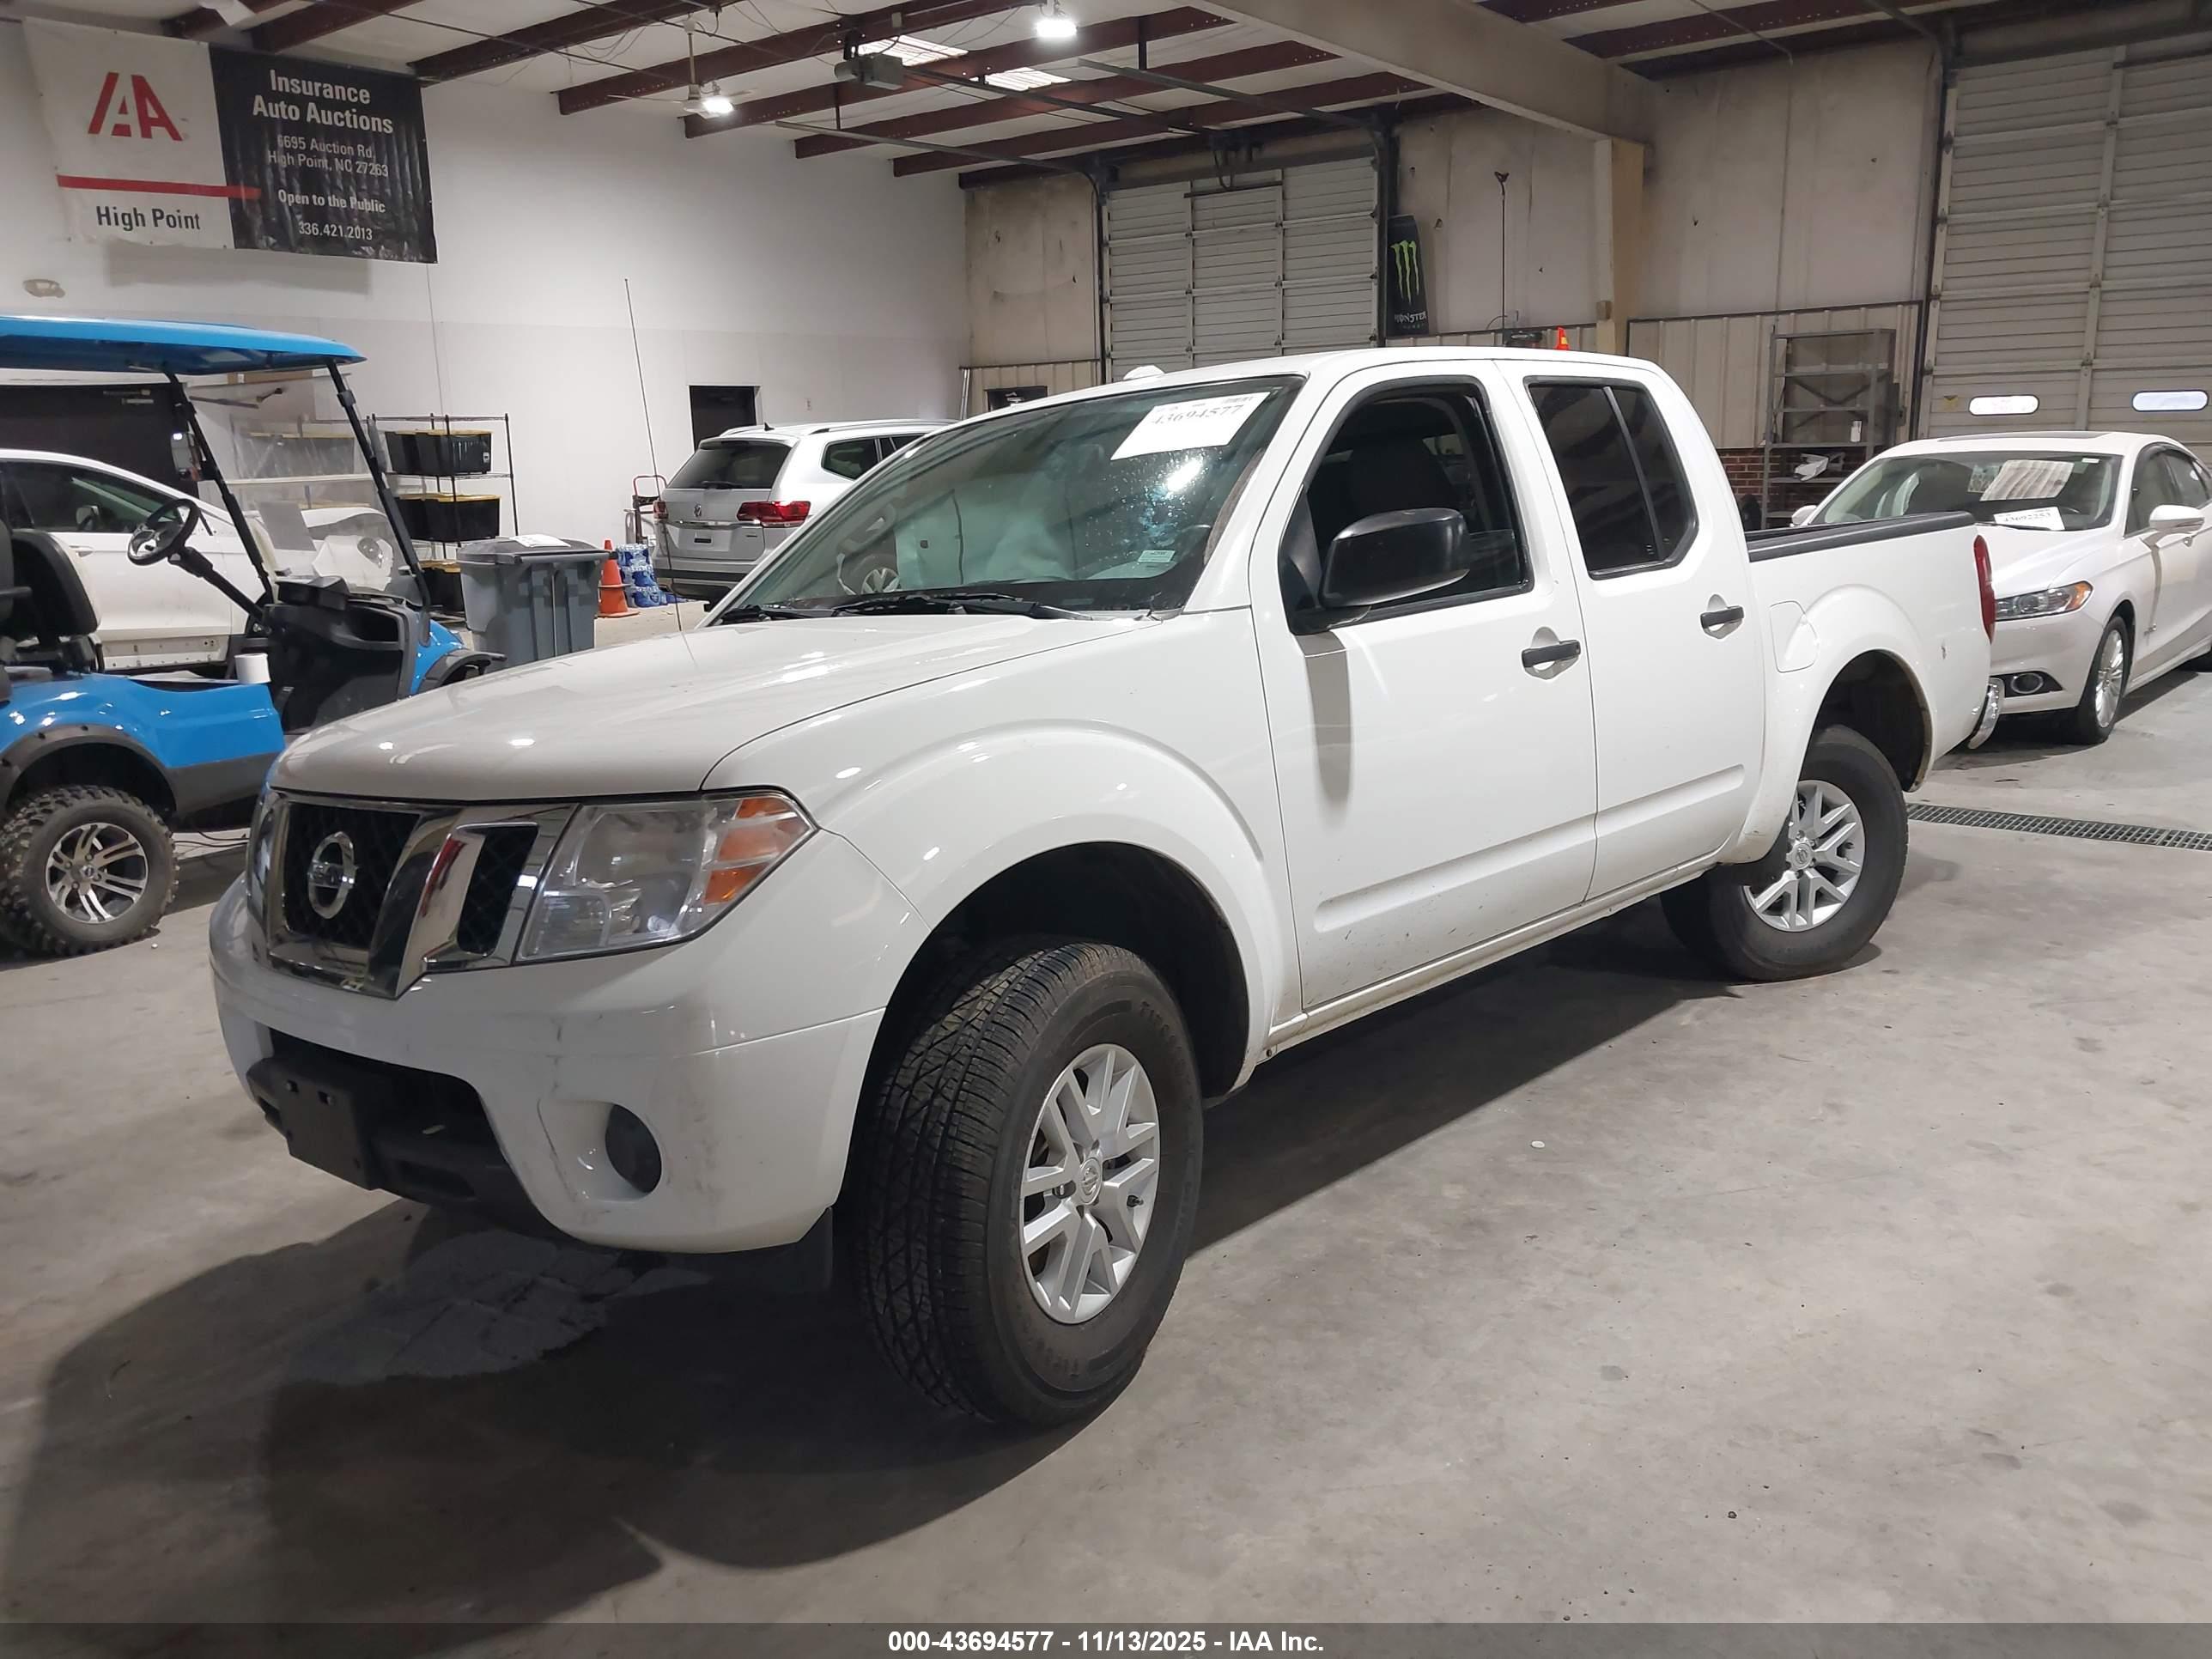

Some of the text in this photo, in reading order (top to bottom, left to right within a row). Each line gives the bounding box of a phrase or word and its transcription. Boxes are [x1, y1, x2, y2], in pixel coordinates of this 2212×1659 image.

[270, 69, 371, 104] Insurance
[252, 94, 393, 134] Auto Auctions
[310, 137, 354, 156] Auction
[268, 150, 295, 168] High
[335, 158, 353, 173] NC
[356, 161, 389, 178] 27263
[277, 189, 386, 214] Open to the Public
[95, 205, 201, 233] High Point
[299, 221, 373, 240] 336.421.2013
[1152, 404, 1245, 425] 43694577
